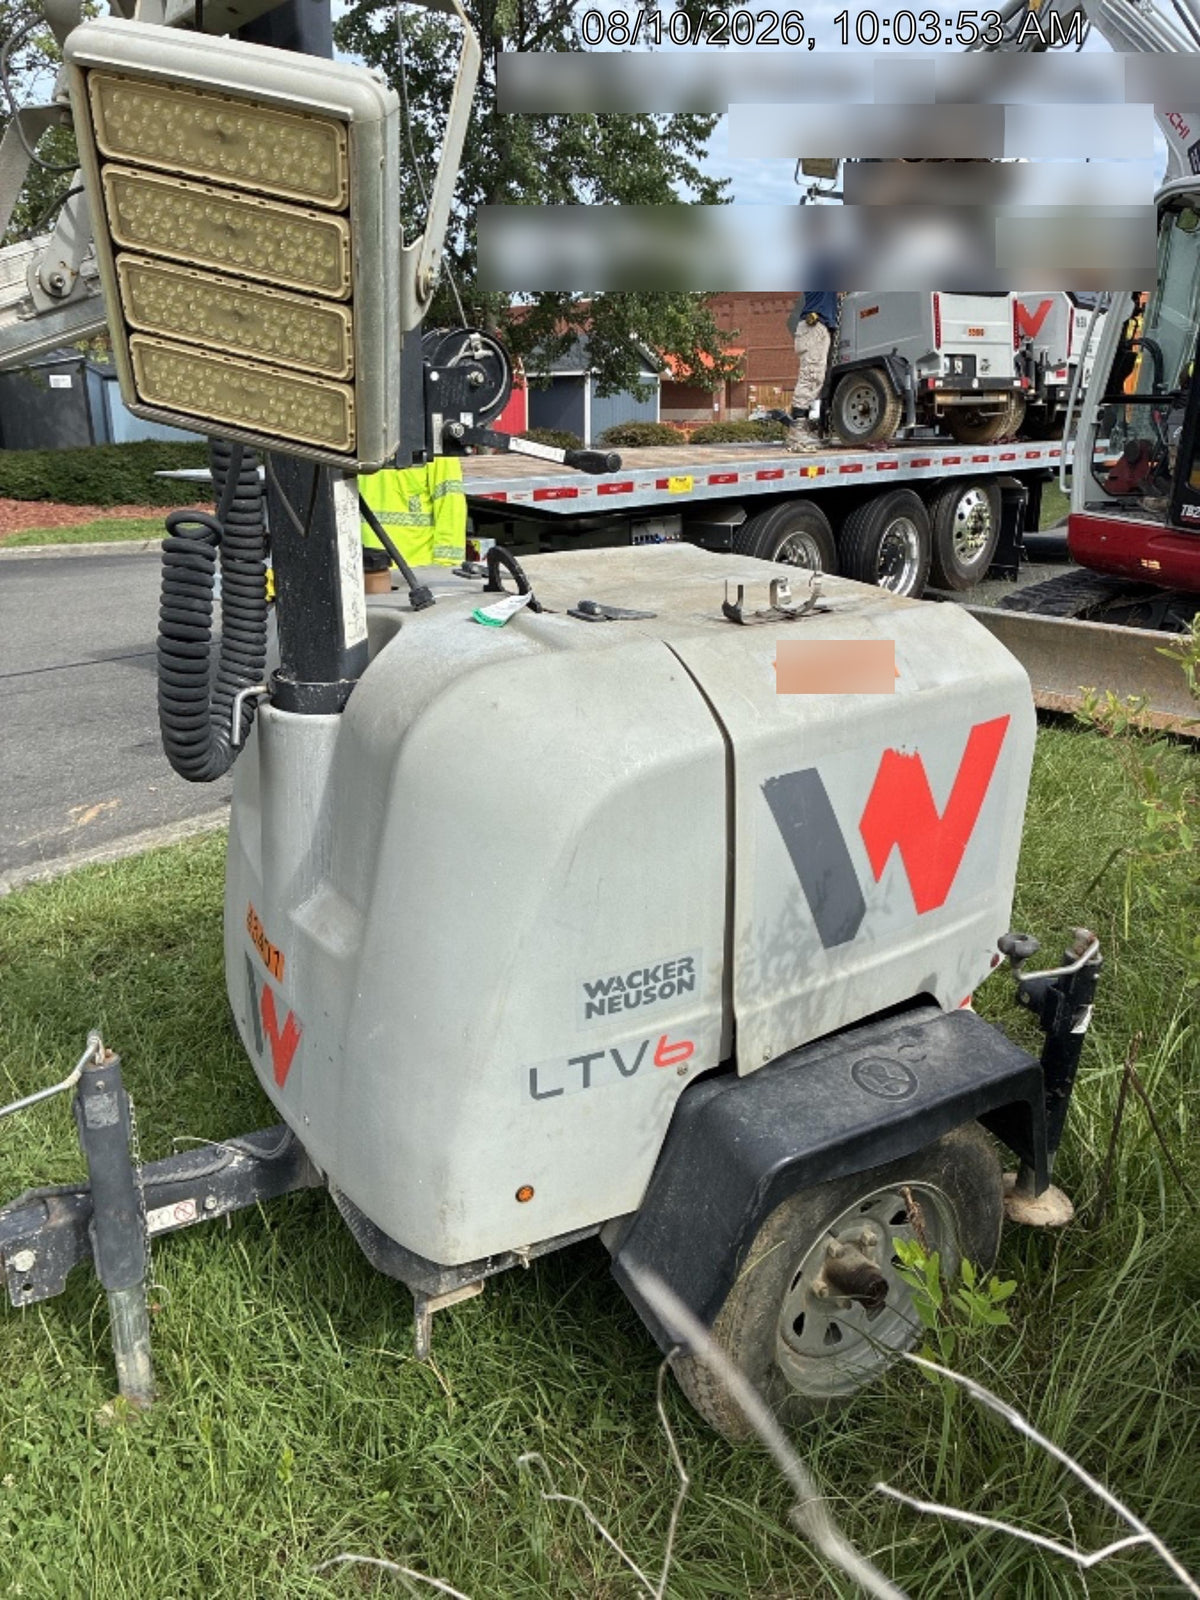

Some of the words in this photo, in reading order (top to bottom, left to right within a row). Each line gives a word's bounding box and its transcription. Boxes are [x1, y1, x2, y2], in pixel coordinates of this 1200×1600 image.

[1165, 113, 1190, 140] CHI
[582, 956, 695, 1000] WACKER
[584, 974, 696, 1019] NEUSON
[529, 1034, 695, 1101] LTV6
